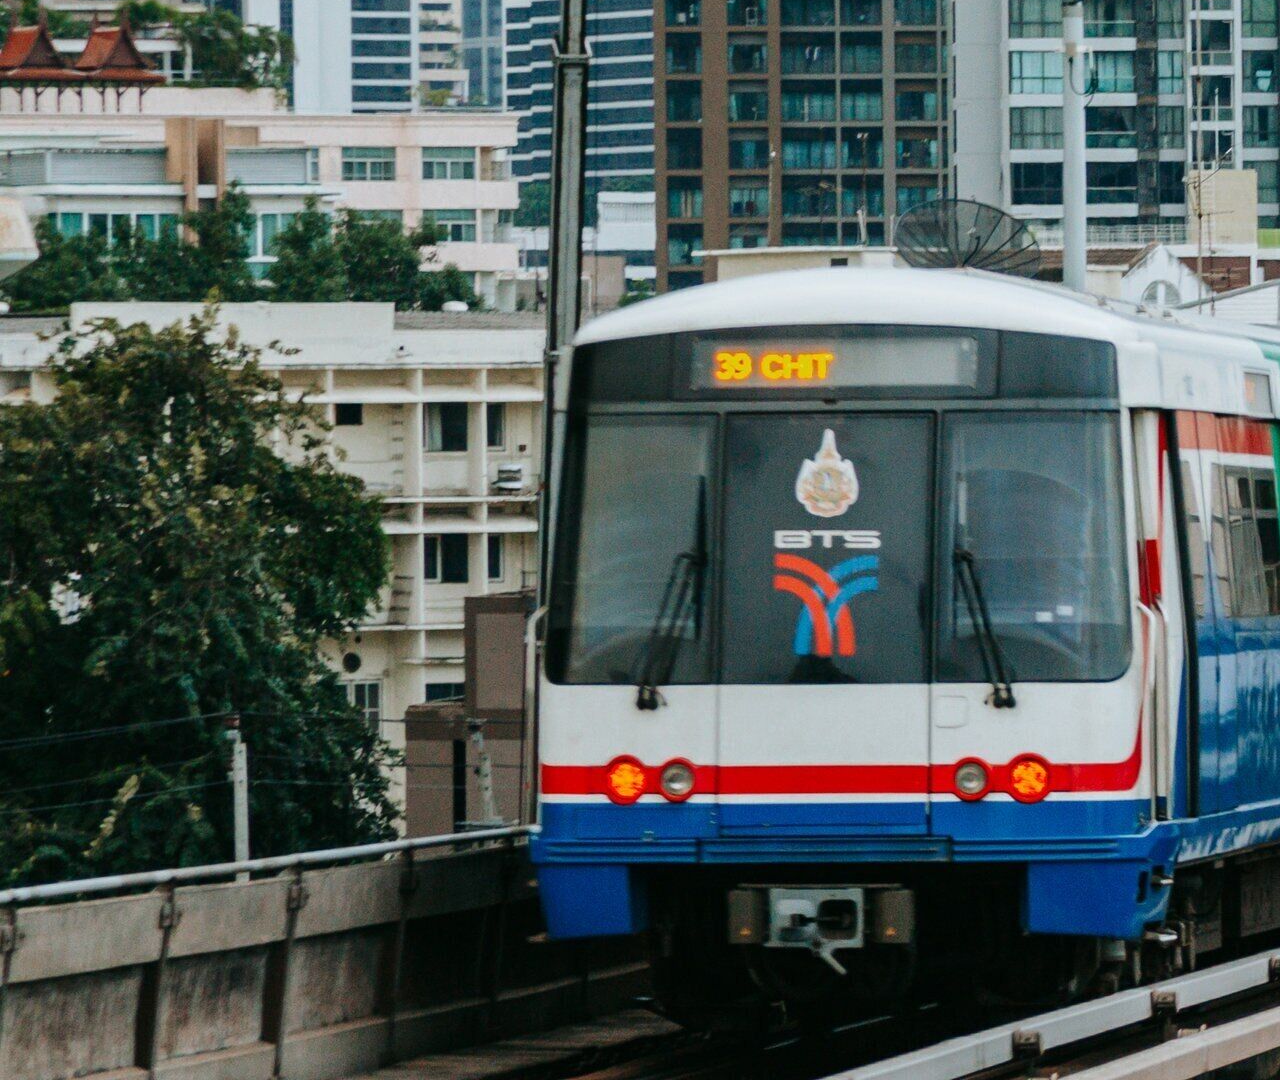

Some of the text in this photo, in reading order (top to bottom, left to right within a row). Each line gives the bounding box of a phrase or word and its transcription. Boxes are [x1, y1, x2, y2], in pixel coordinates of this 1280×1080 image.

[716, 351, 835, 380] 39 CHIT
[774, 529, 882, 549] BTS
